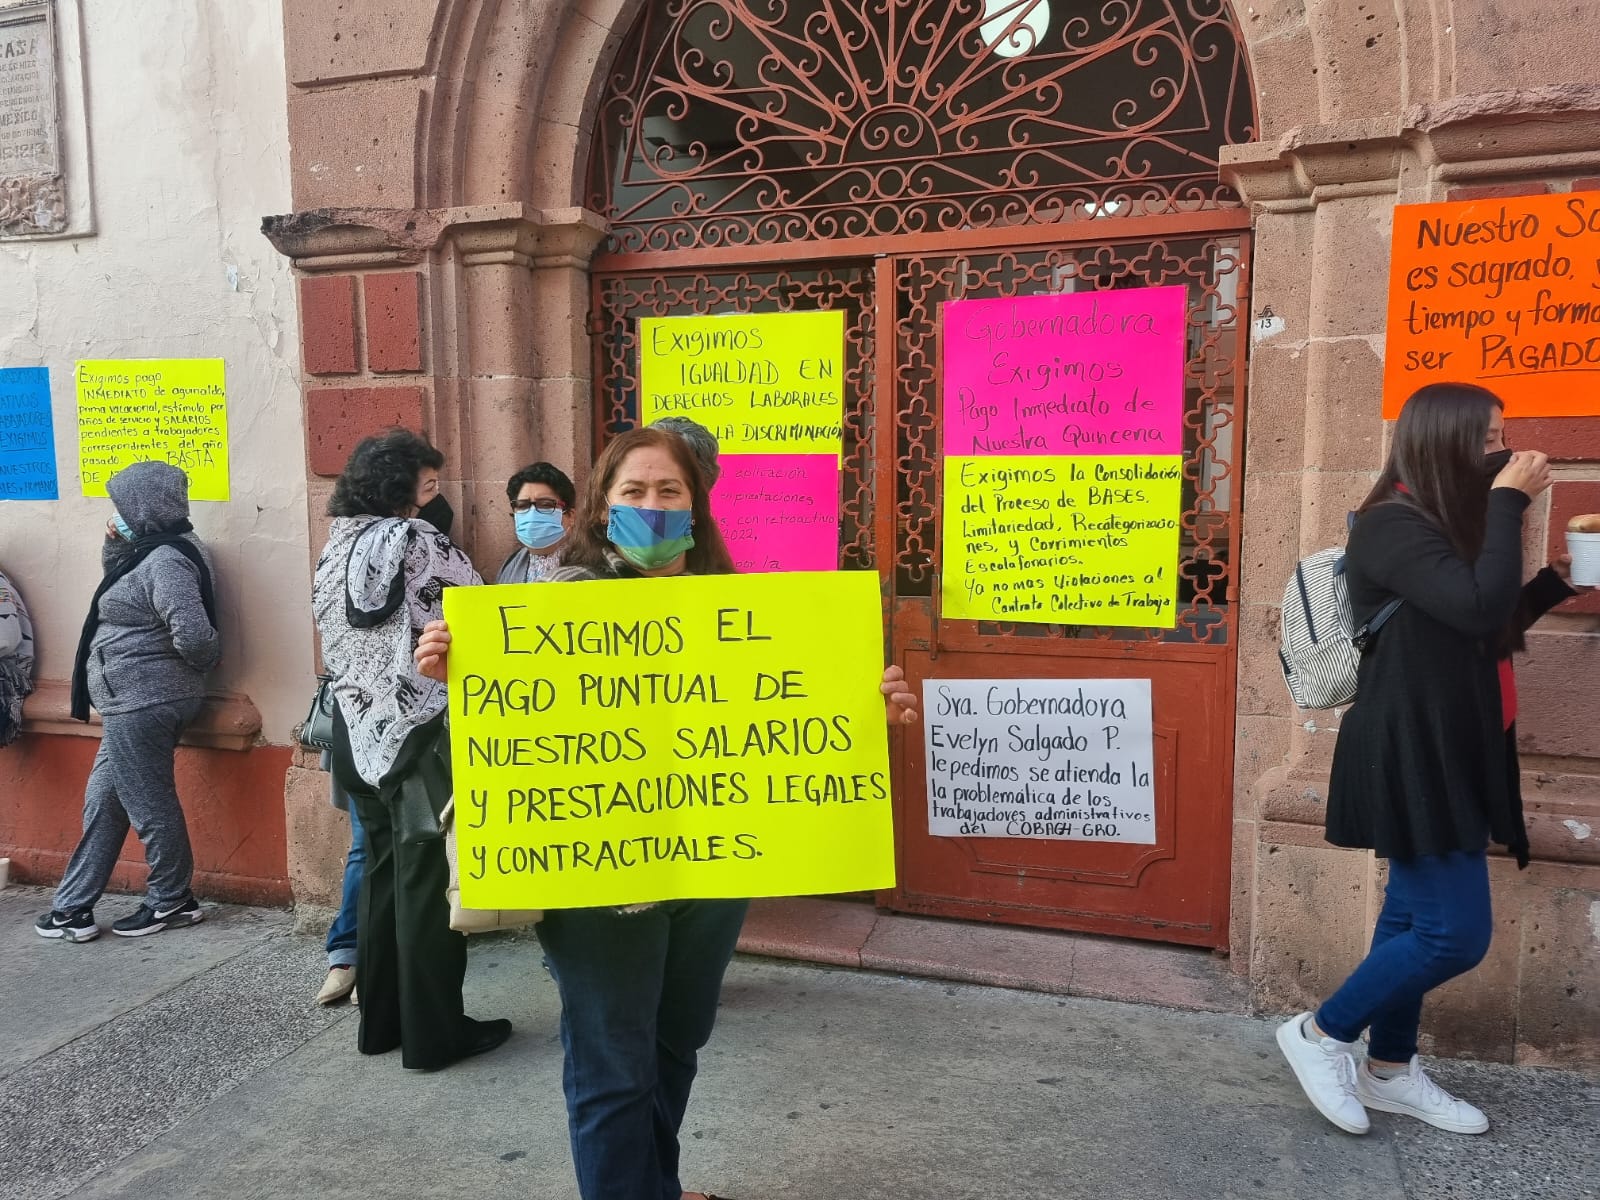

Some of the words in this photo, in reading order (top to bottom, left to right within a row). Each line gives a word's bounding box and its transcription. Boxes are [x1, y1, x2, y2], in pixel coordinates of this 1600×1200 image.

[0, 39, 39, 58] ASA
[1417, 206, 1540, 249] Nuestro
[1406, 265, 1438, 292] es
[1448, 243, 1575, 299] sagrado,
[966, 299, 1160, 352] Gobernadora
[1261, 319, 1271, 329] 13
[1402, 300, 1495, 339] tiempo
[1506, 310, 1521, 336] y
[681, 359, 779, 386] IGUALDAD
[799, 359, 832, 380] EN
[988, 352, 1123, 390] Exigimos
[1404, 350, 1453, 371] ser
[80, 365, 130, 390] Exigimos
[135, 373, 162, 387] pago
[83, 388, 147, 401] INMEDIATO
[154, 386, 166, 396] de
[172, 385, 225, 399] aguinaldo,
[651, 391, 734, 413] DERECHOS
[750, 390, 838, 409] LABORALES
[79, 405, 105, 415] prima
[109, 401, 161, 414] vacacional,
[210, 404, 225, 414] por
[79, 416, 103, 426] años
[106, 416, 117, 424] de
[154, 418, 160, 427] y
[163, 415, 211, 425] SALARIOS
[958, 387, 998, 431] Pago
[1014, 388, 1110, 420] Inmediato
[1124, 387, 1155, 413] de
[80, 427, 138, 441] pendientes
[155, 425, 220, 438] trabajadores
[717, 425, 734, 440] LA
[741, 421, 843, 441] DISCRIMINACIÓN
[973, 425, 1048, 455] Nuestra
[1062, 425, 1165, 448] Quincena
[81, 438, 169, 453] correspondientes
[178, 439, 195, 449] del
[202, 440, 223, 449] año
[166, 449, 215, 469] BASTA
[82, 471, 101, 483] DE
[961, 463, 1056, 491] Exigimos
[1070, 463, 1085, 482] la
[1095, 463, 1181, 482] Consolidación
[961, 494, 985, 514] del
[996, 493, 1050, 513] Proceso
[1057, 489, 1077, 507] de
[1089, 486, 1149, 505] BASES.
[737, 516, 759, 525] con
[963, 513, 1062, 538] Limitariedad,
[966, 539, 998, 554] nes,
[1008, 539, 1020, 556] y
[1030, 534, 1128, 551] Corrimientos
[964, 578, 984, 603] Ya
[1054, 573, 1135, 590] Violaciones
[1143, 567, 1163, 584] al
[991, 597, 1043, 614] Contrato
[1051, 594, 1102, 611] Colectivo
[1108, 595, 1120, 607] de
[1122, 591, 1171, 616] Trabajo
[717, 607, 772, 642] EL
[463, 674, 556, 717] PAGO
[579, 673, 729, 708] PUNTUAL
[754, 671, 808, 701] DE
[937, 685, 978, 718] Sra.
[987, 686, 1127, 719] Gobernadora
[469, 728, 648, 767] NUESTROS
[673, 715, 853, 759] SALARIOS
[931, 724, 998, 755] Evelyn
[1007, 724, 1088, 761] Salgado
[1102, 725, 1120, 750] P.
[932, 751, 947, 772] le
[950, 756, 1019, 781] pedimos
[1029, 765, 1049, 782] se
[1054, 760, 1121, 785] atienda
[1132, 761, 1150, 788] la
[508, 772, 749, 825] PRESTACIONES
[767, 772, 887, 806] LEGALES
[931, 779, 947, 799] la
[953, 781, 1055, 805] problemática
[1062, 786, 1083, 806] de
[1088, 790, 1112, 807] los
[931, 800, 1026, 825] trabajadores
[1034, 806, 1151, 822] administrativos
[959, 823, 986, 835] del
[497, 833, 763, 874] CONTRACTUALES.
